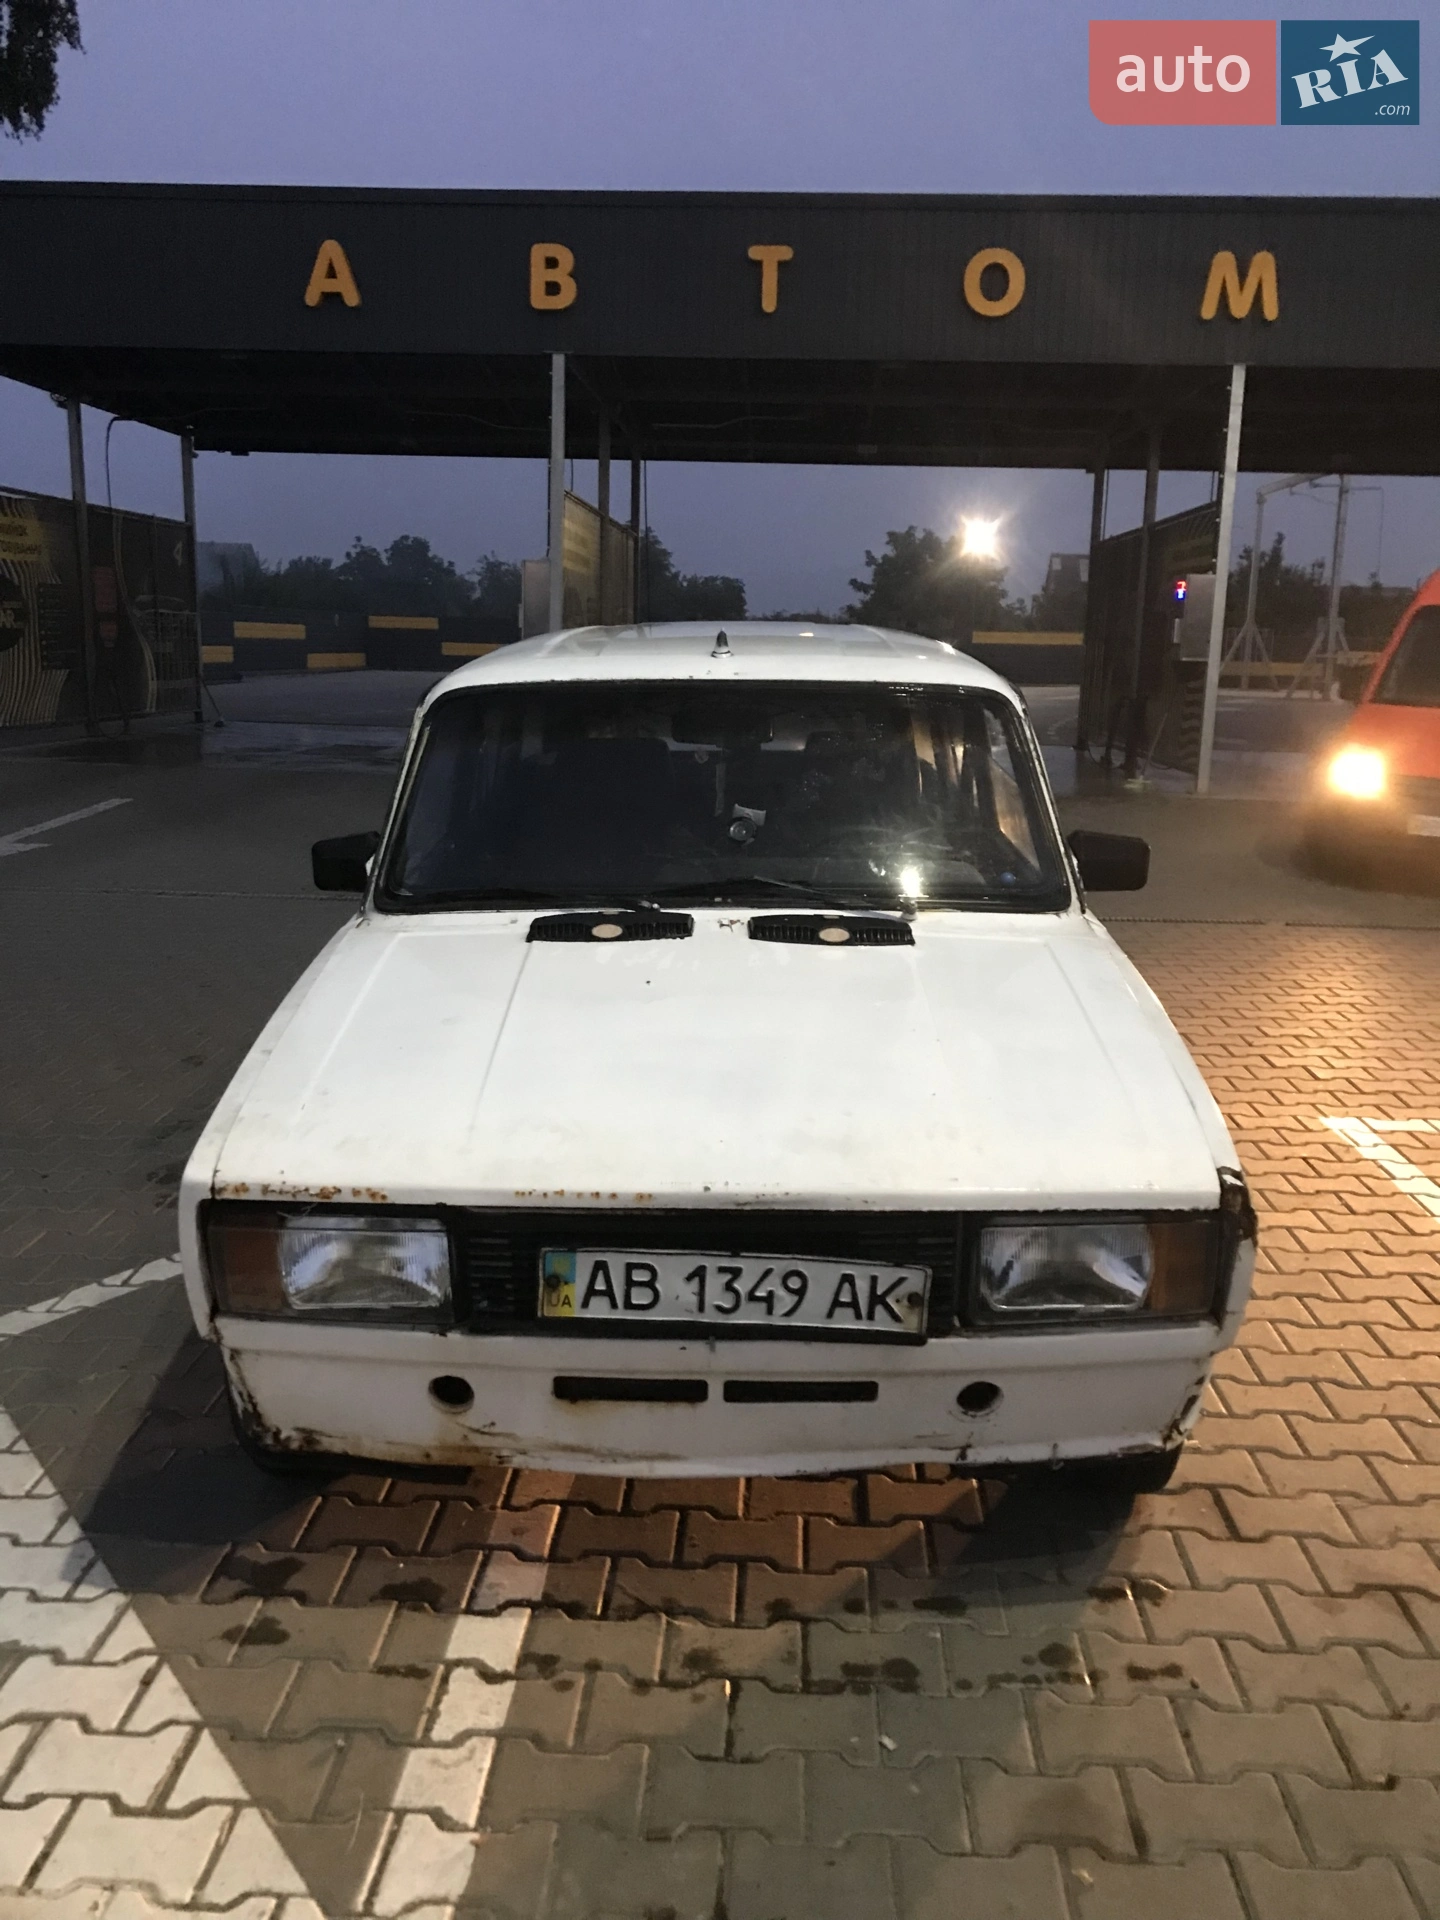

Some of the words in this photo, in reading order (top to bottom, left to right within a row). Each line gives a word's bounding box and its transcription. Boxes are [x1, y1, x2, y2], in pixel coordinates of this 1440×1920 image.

[580, 1259, 662, 1312] AB
[683, 1263, 809, 1318] 1349
[826, 1272, 909, 1324] AK
